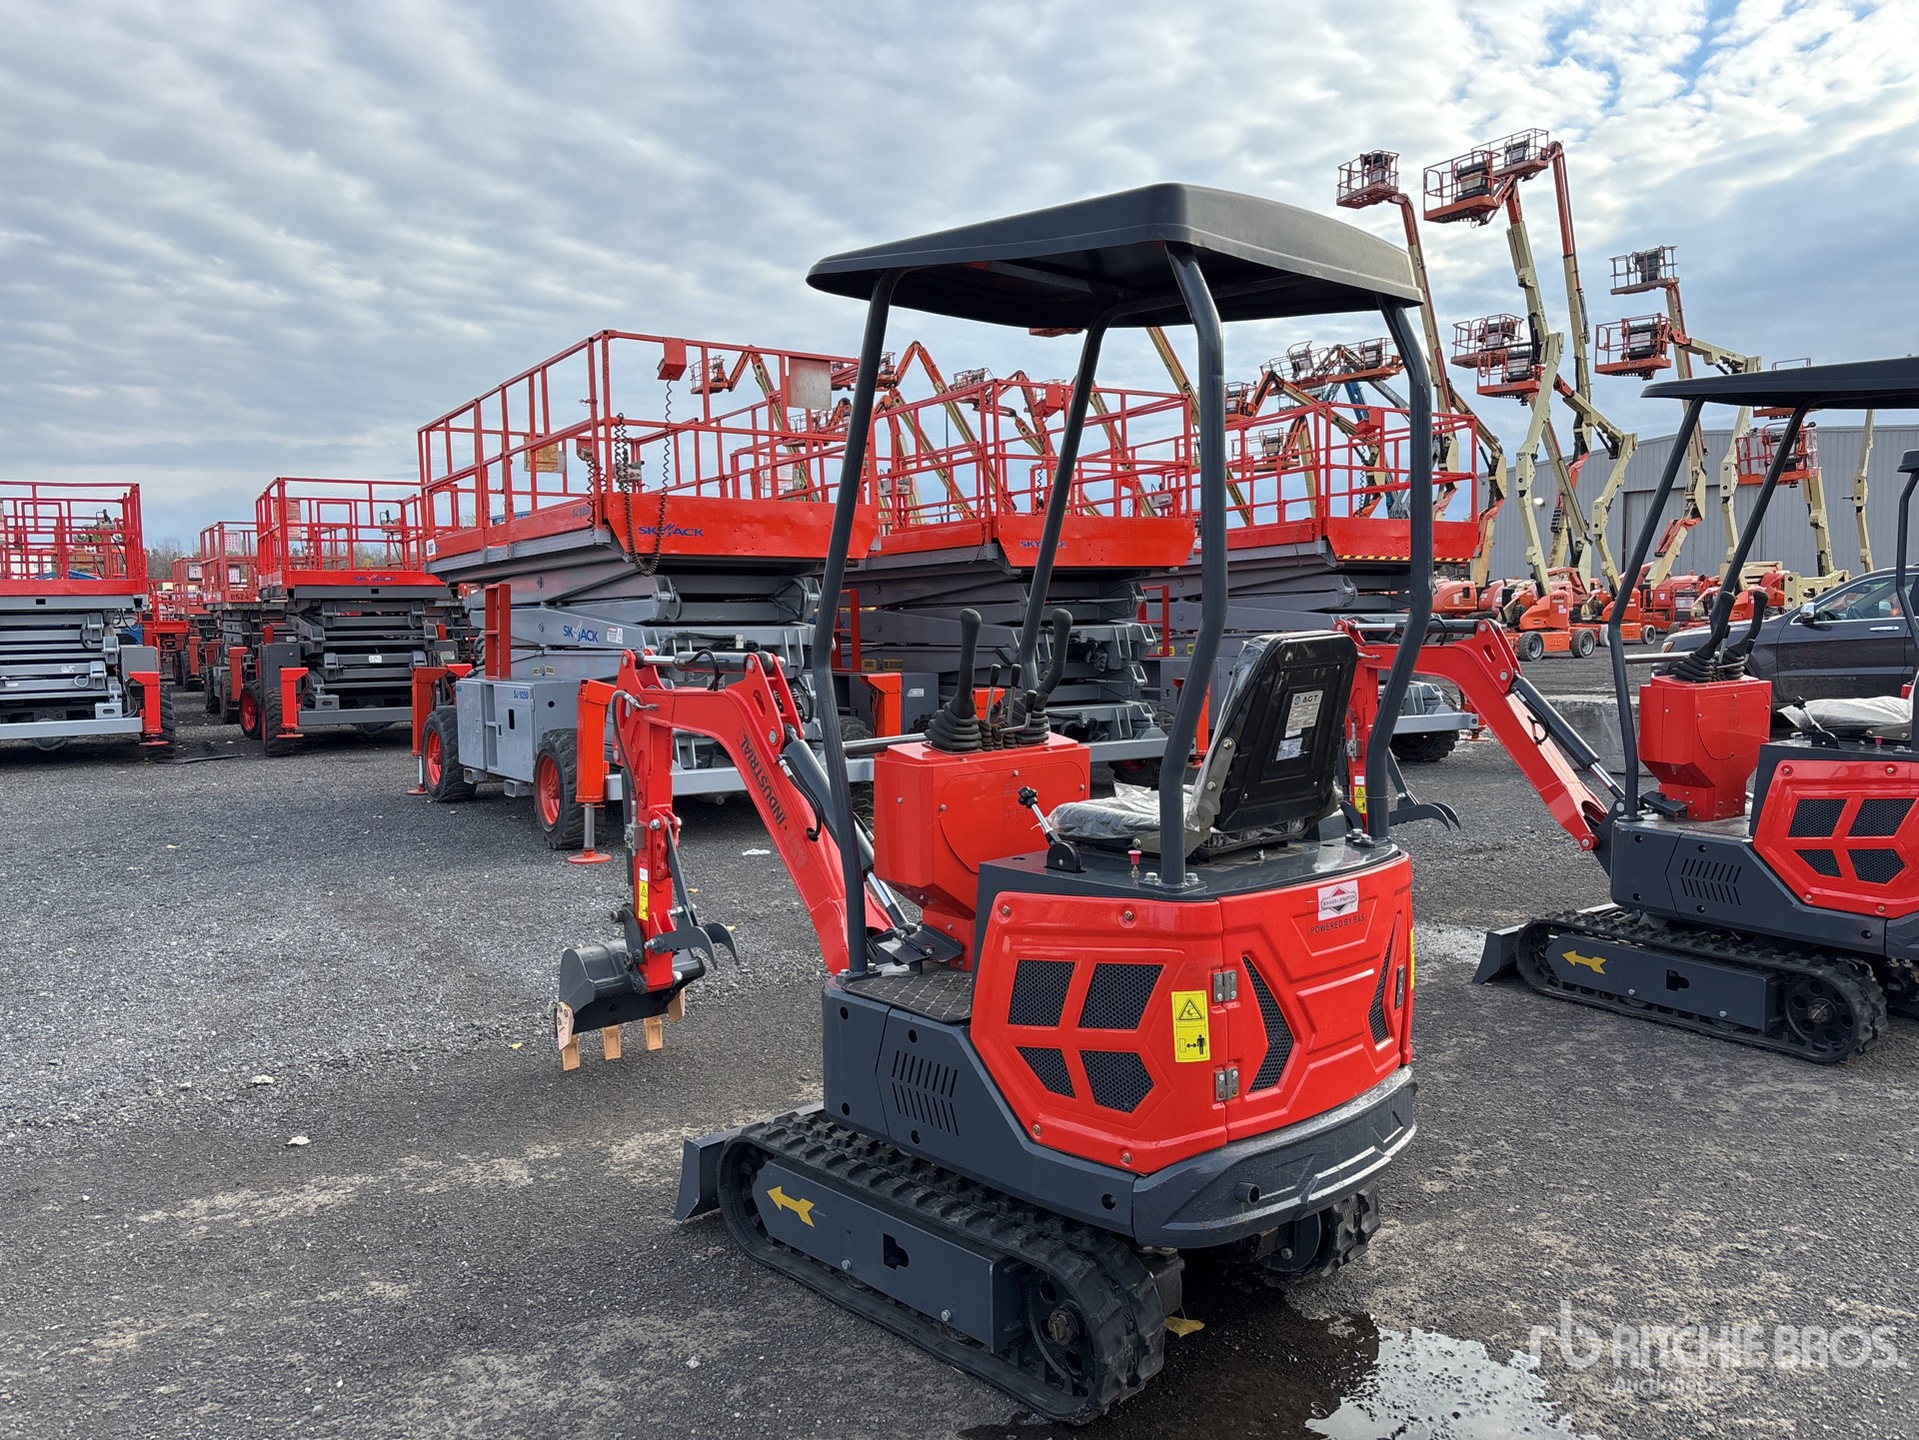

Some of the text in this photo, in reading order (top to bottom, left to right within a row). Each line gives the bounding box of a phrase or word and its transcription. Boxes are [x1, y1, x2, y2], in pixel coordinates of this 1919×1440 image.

[638, 523, 704, 537] SKYJACK
[563, 621, 599, 643] SKYJACK
[1302, 694, 1319, 703] AGT
[740, 733, 786, 825] INDUSTRIAL
[1310, 920, 1343, 935] POWERED
[1344, 917, 1353, 927] BY
